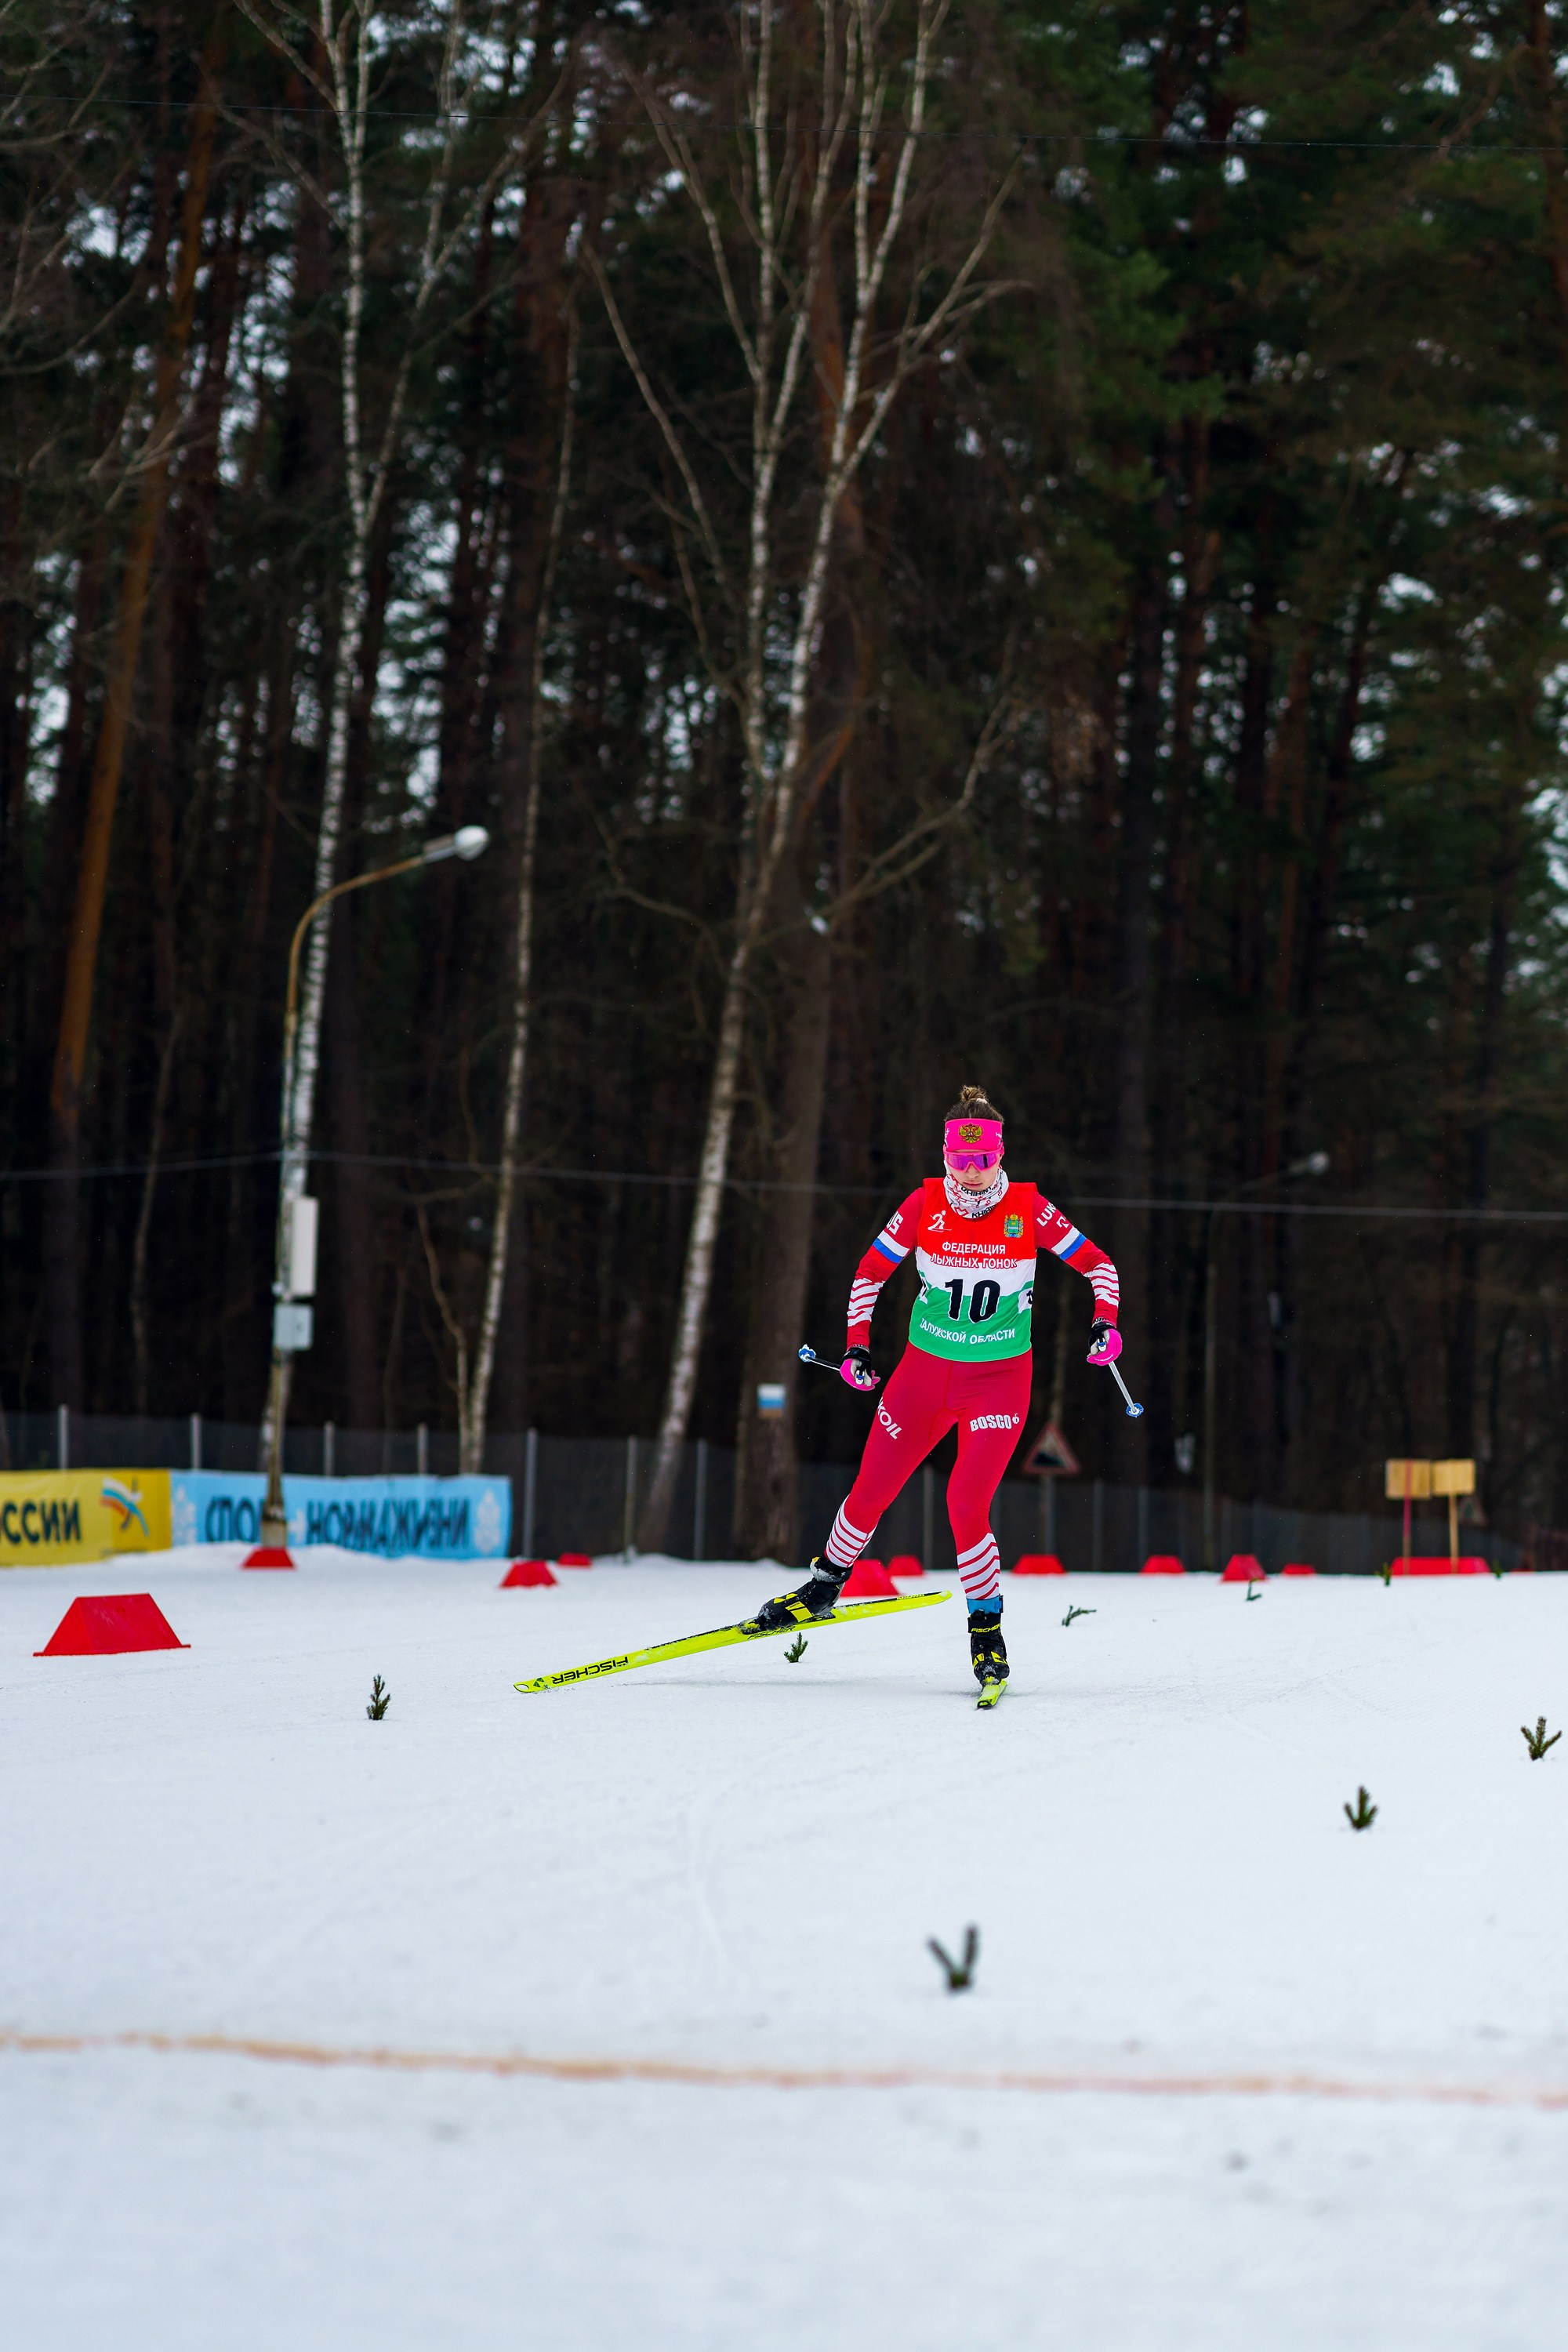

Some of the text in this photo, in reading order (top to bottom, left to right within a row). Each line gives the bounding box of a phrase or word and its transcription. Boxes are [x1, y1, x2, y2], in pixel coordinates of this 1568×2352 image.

[942, 1241, 1006, 1256] ФЕДЕРАЦИЯ
[931, 1253, 1018, 1269] ЛЫЖНЫХ ГОНОК
[945, 1279, 1001, 1323] 10
[969, 1328, 1016, 1345] ОБЛАСТИ
[970, 1414, 1012, 1432] BOSCO
[971, 1623, 1000, 1633] FISCHER
[551, 1656, 629, 1685] FISCHER
